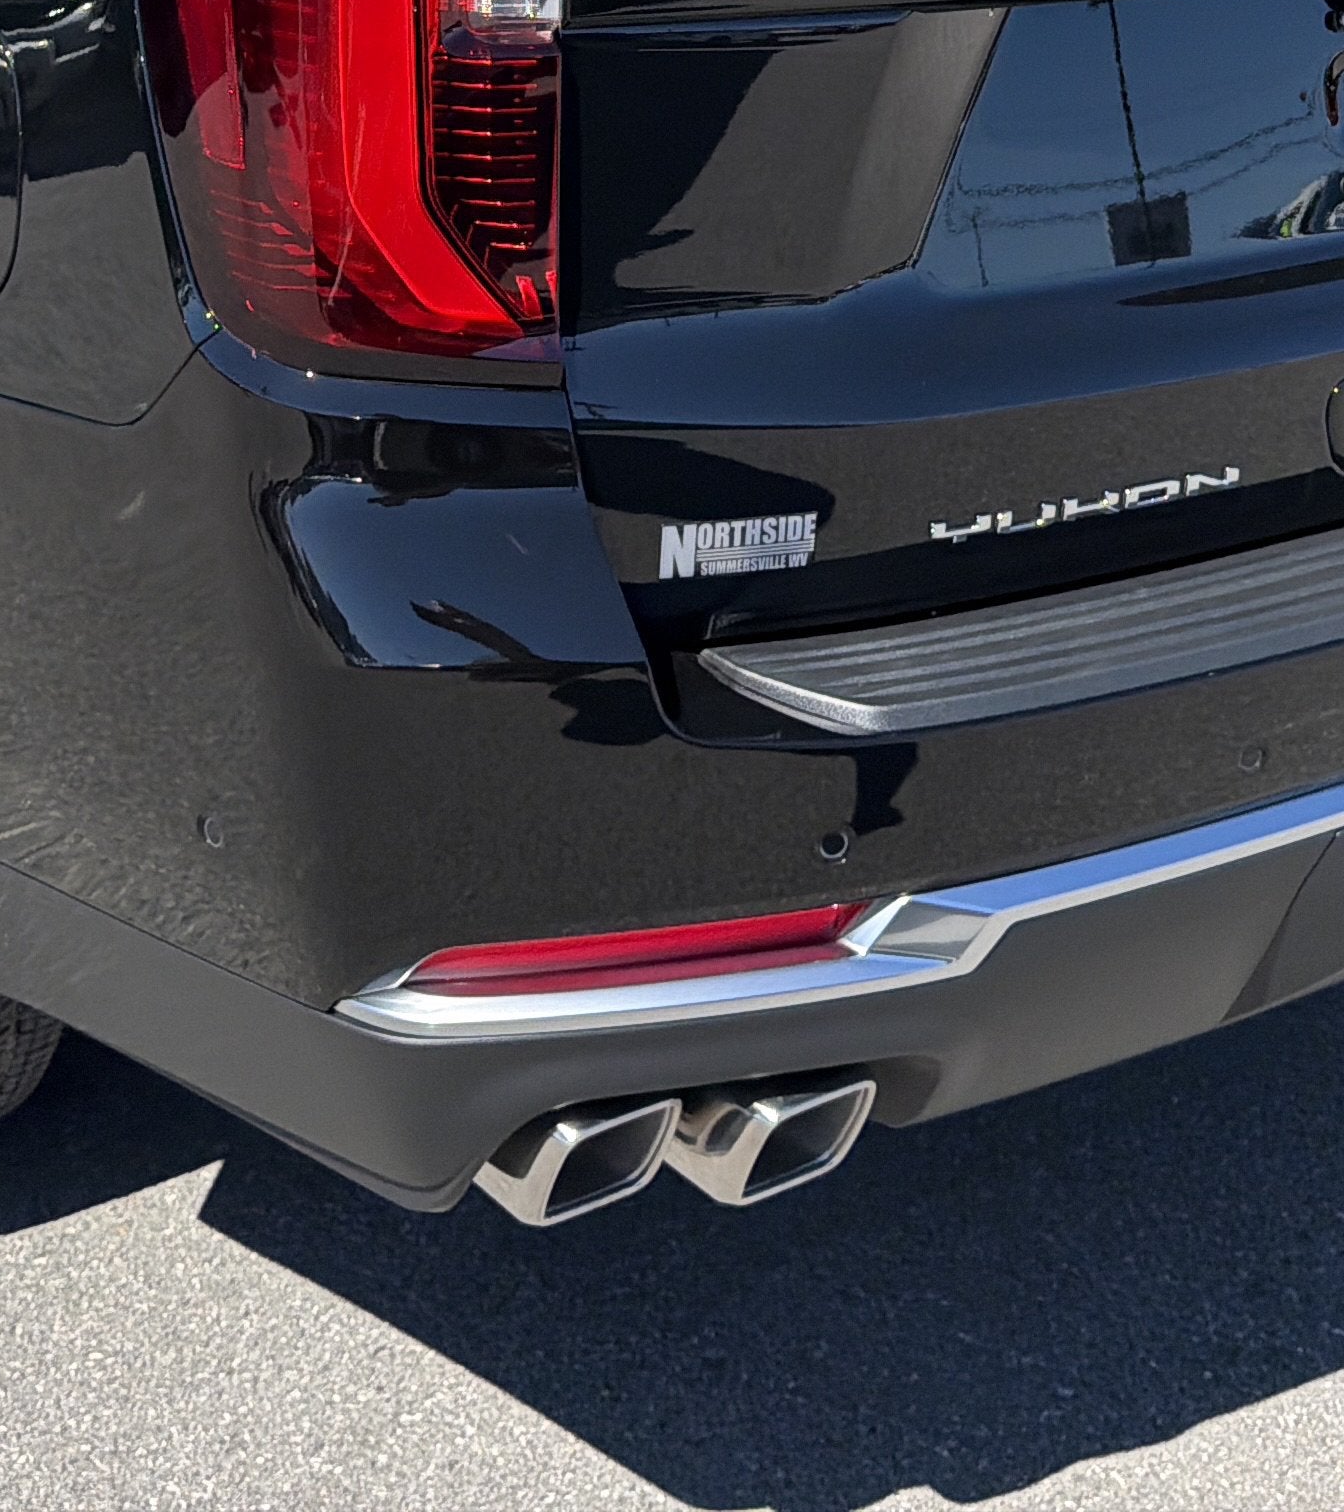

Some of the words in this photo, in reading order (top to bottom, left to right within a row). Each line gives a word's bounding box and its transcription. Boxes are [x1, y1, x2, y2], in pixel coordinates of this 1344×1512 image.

[930, 465, 1240, 543] YUKON
[659, 512, 818, 579] NORTHSIDE
[701, 554, 786, 576] SUMMERSVILLE
[788, 553, 809, 568] WV
